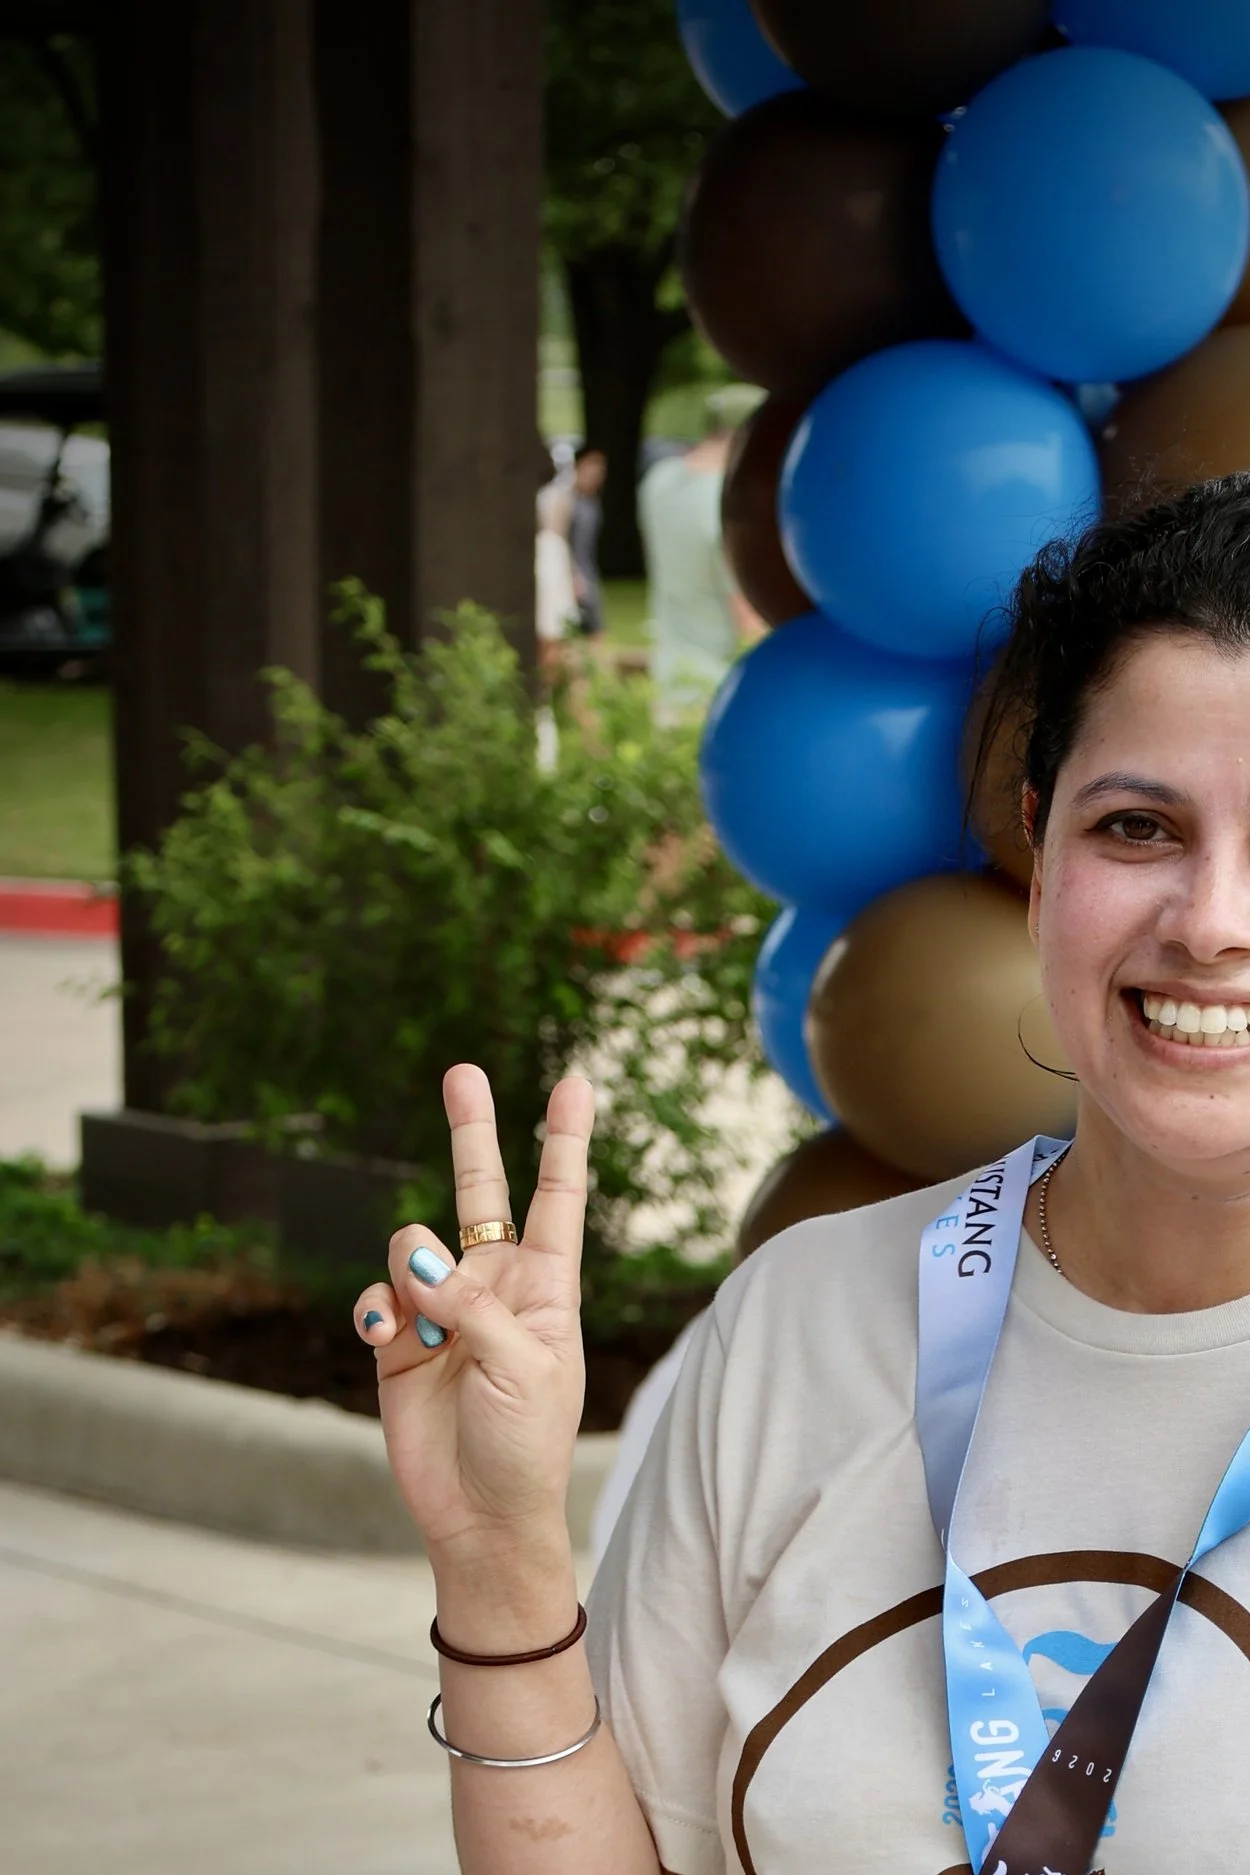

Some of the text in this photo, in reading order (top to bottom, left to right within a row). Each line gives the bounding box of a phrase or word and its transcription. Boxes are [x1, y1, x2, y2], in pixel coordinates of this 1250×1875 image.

[957, 1157, 1008, 1278] USTANG
[960, 1598, 996, 1697] LAKES
[1051, 1748, 1113, 1784] 2026
